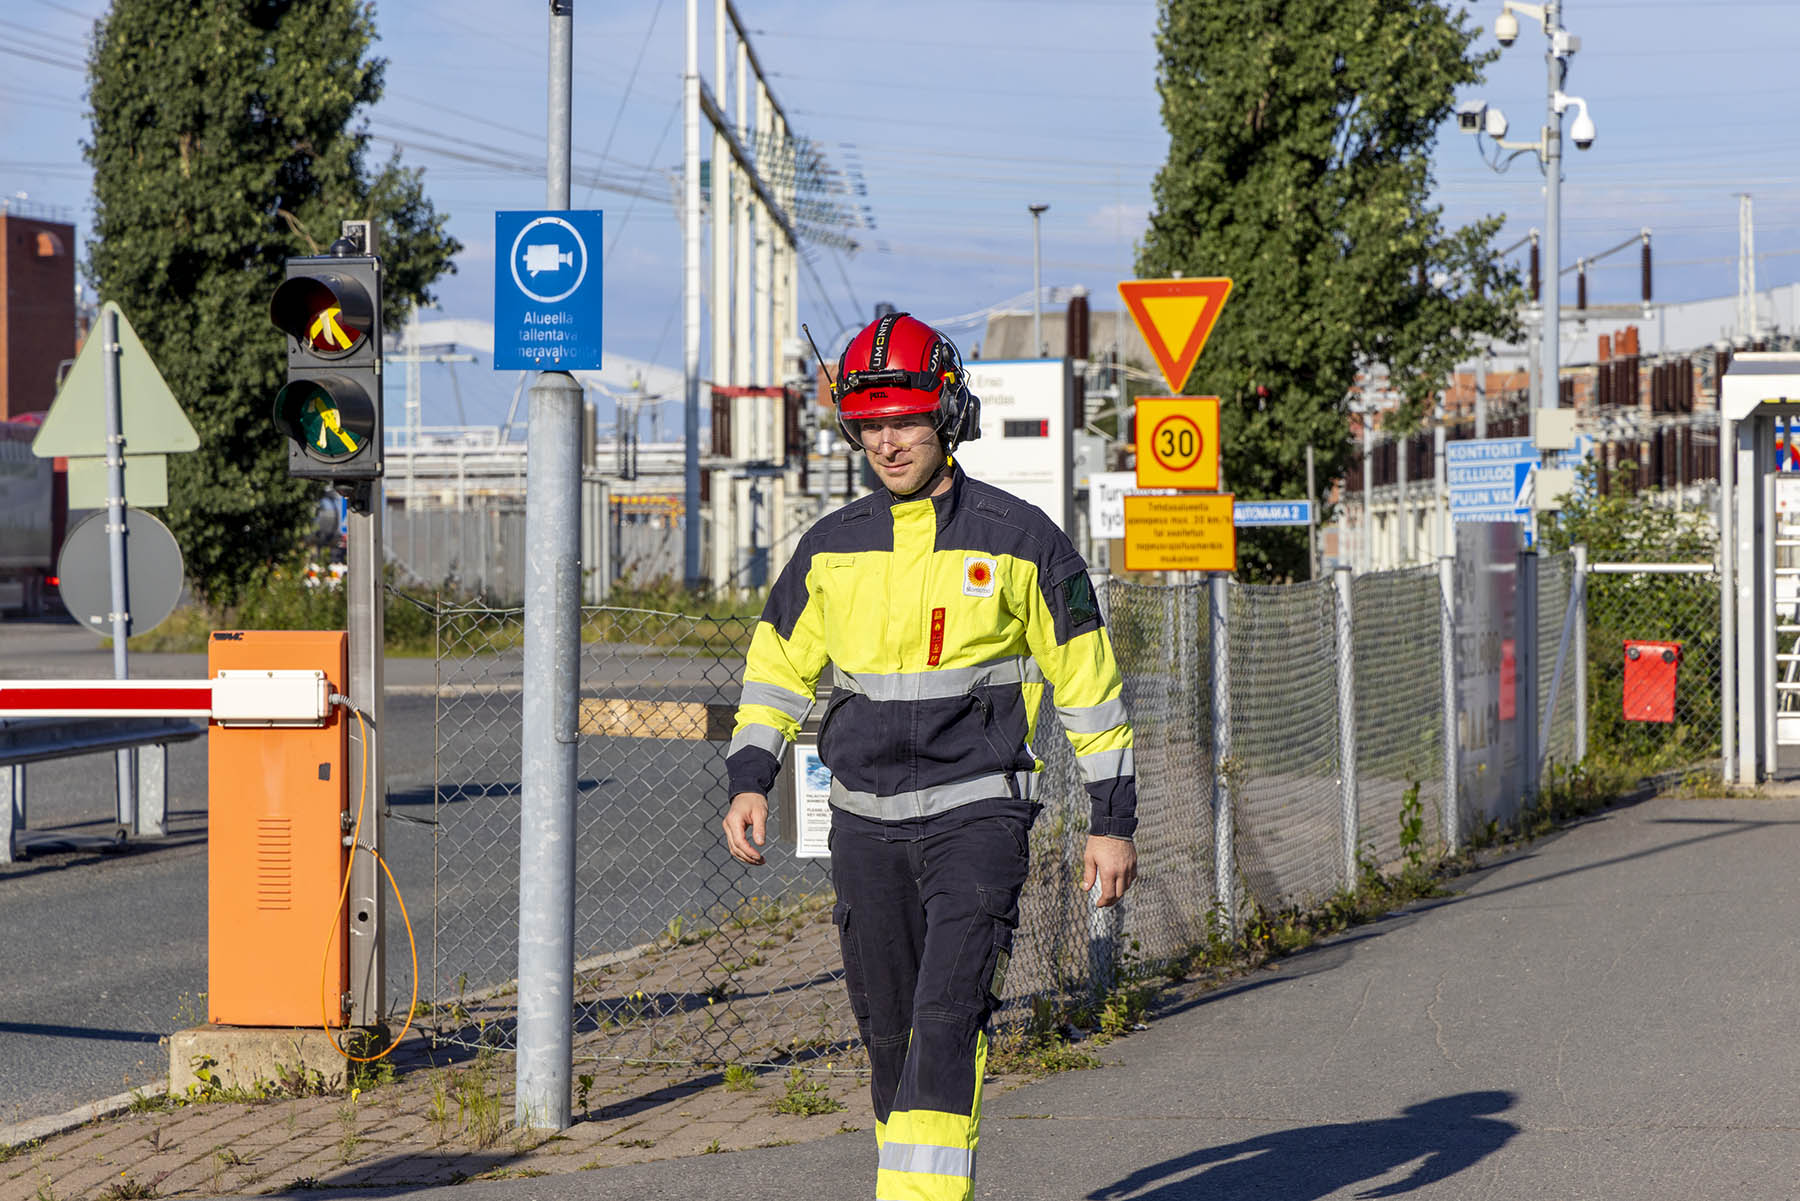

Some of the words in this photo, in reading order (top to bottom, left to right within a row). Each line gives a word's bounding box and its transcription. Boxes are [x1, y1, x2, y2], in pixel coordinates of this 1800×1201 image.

[523, 312, 574, 325] Alueella
[519, 328, 577, 341] tallentava
[873, 317, 892, 367] UMONITE
[1161, 429, 1193, 457] 30
[1448, 442, 1522, 459] KONTTORIT
